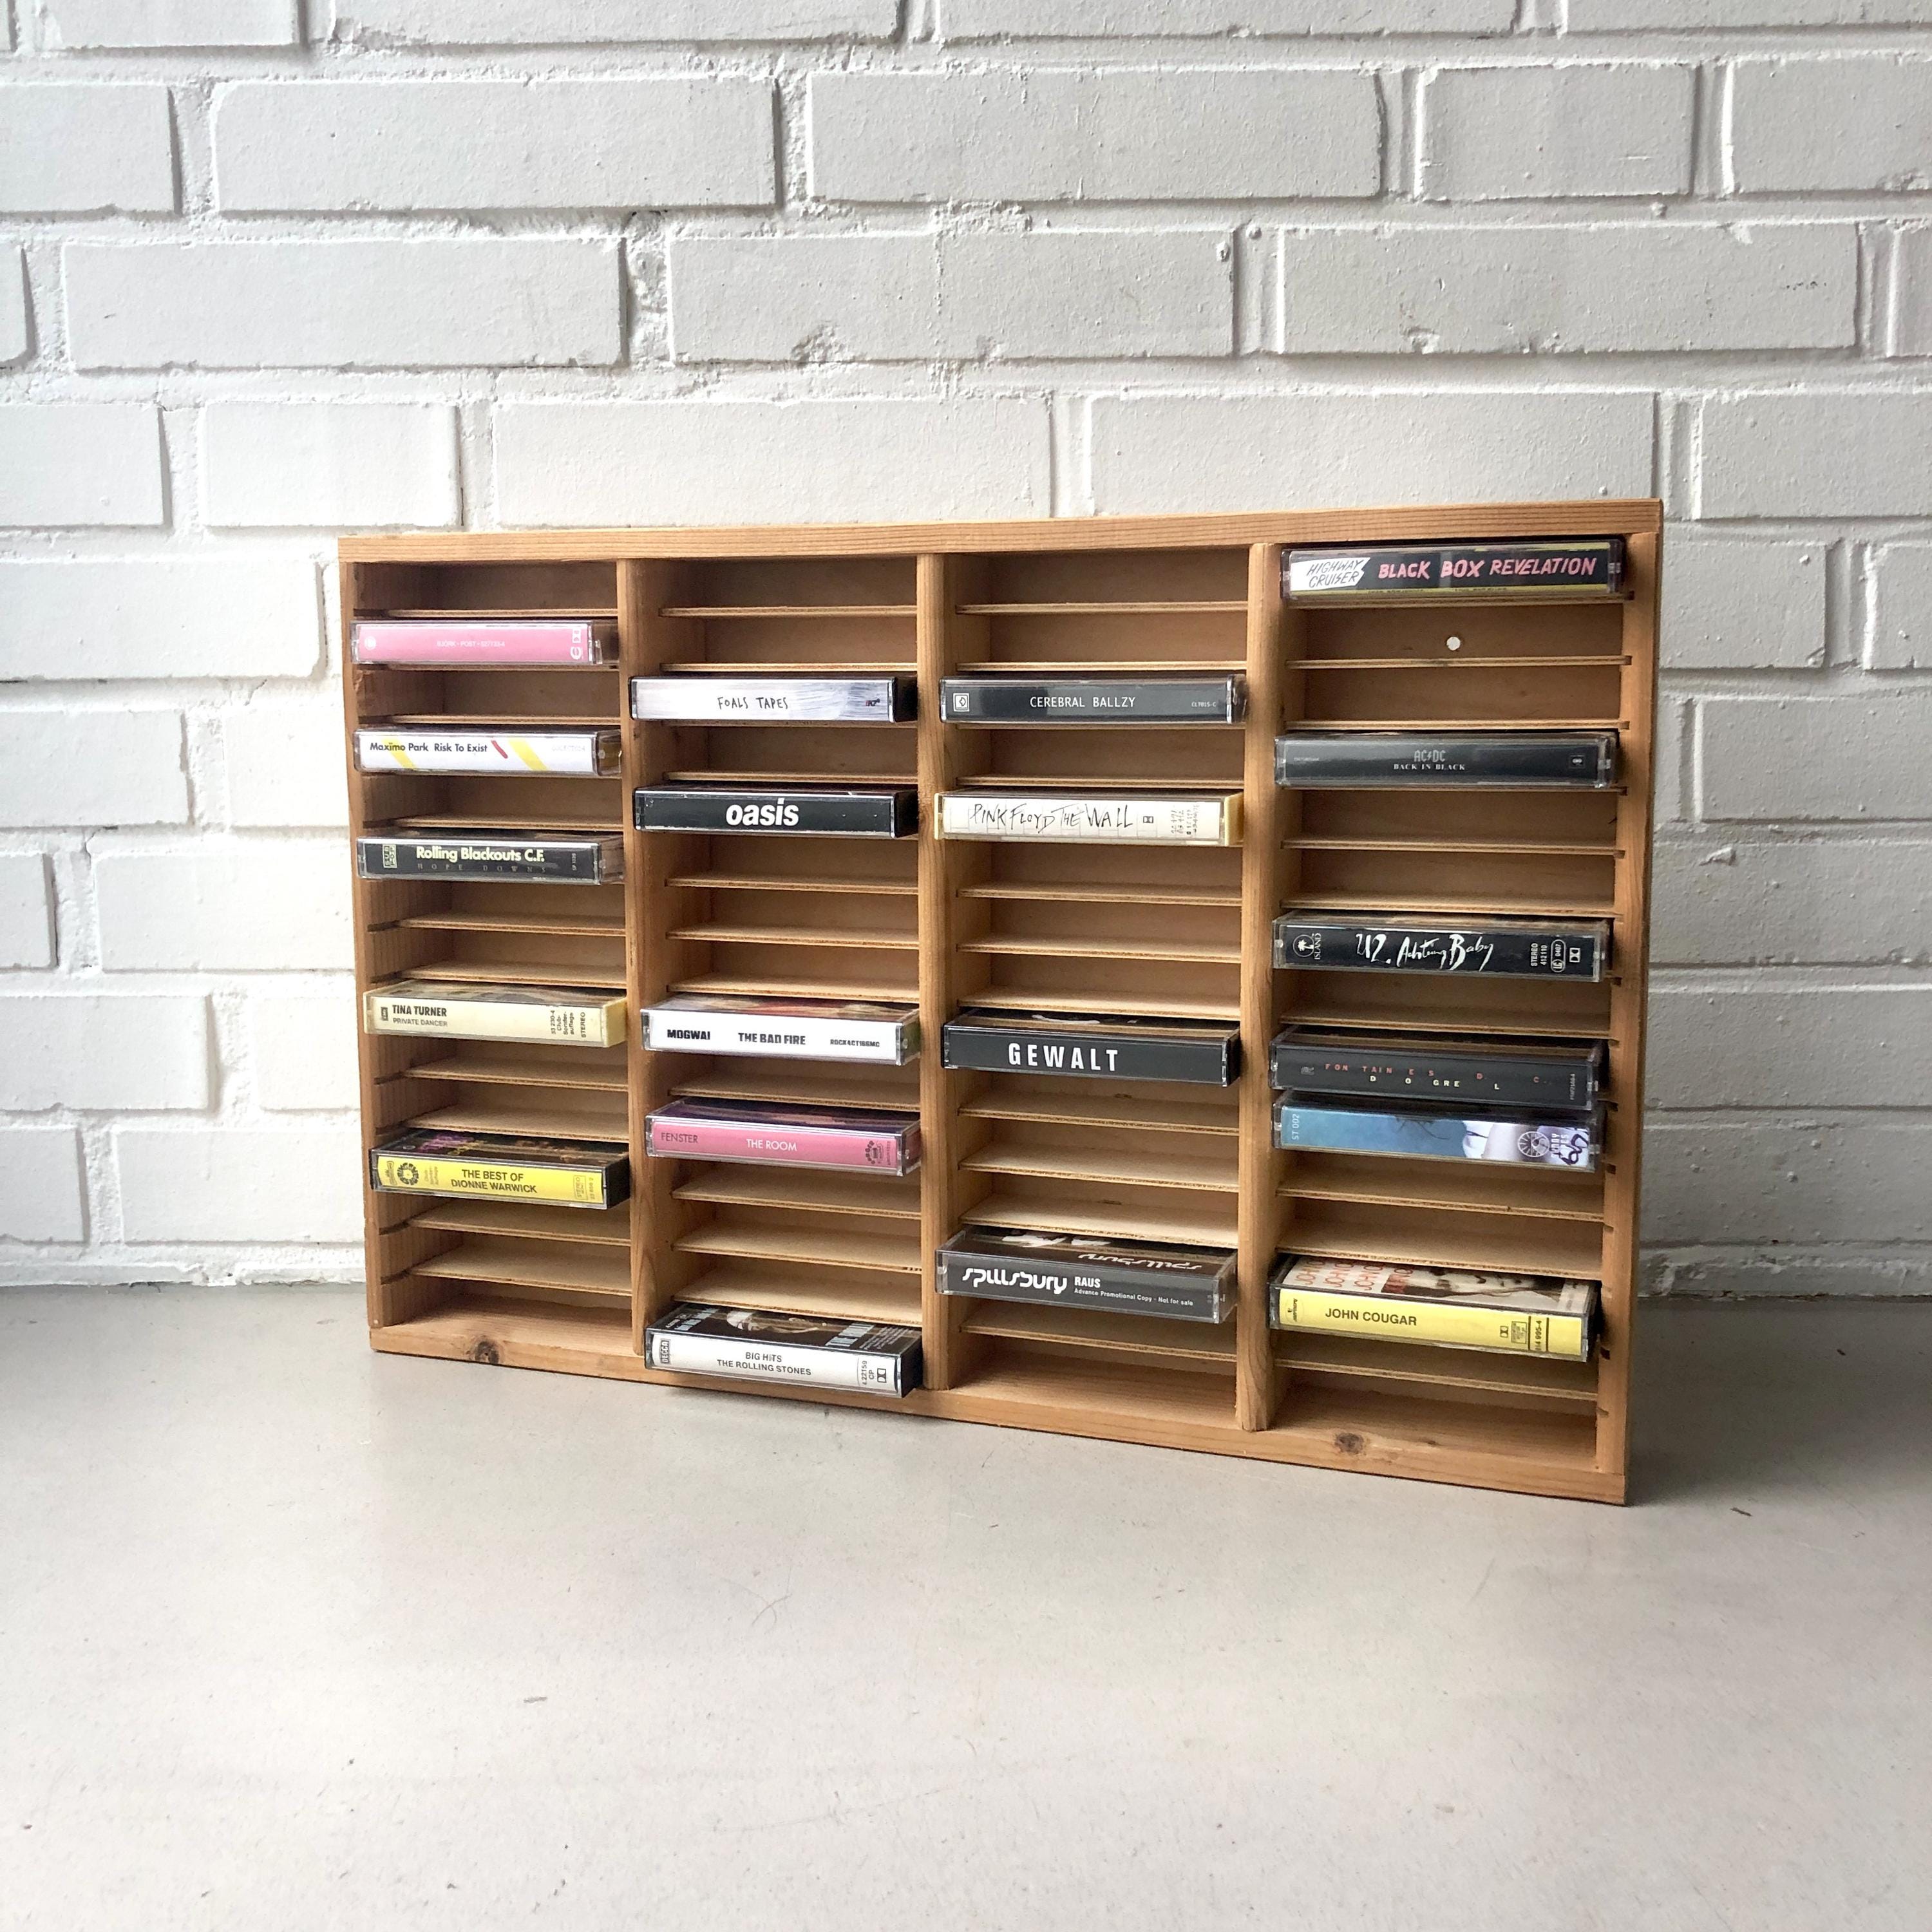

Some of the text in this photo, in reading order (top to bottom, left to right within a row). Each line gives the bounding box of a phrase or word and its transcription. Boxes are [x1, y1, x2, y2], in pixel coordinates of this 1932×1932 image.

[1307, 558, 1365, 576] HIGHWAY
[1378, 557, 1597, 580] BLACK BOX REVELATION
[1309, 571, 1359, 589] CRUISER
[717, 697, 788, 710] FOALS TAPES
[1030, 696, 1136, 708] CEREBRAL BALLZY
[408, 743, 428, 752] Park
[434, 743, 452, 752] Risk
[455, 744, 464, 752] To
[467, 744, 487, 753] Exist
[726, 798, 799, 826] oasis
[969, 803, 1133, 834] PINK FLOYD THE WALL
[416, 845, 545, 863] Rolling Blackouts C.F.
[483, 865, 546, 873] DOWNS
[1449, 934, 1493, 971] Baby
[392, 1004, 412, 1015] TINA
[414, 1006, 448, 1017] TURNER
[421, 1019, 448, 1027] DANCER
[667, 1029, 806, 1045] MOGWAI THE BAD FIRE
[1008, 1043, 1119, 1072] GEWALT
[661, 1132, 797, 1151] FENSTER THE ROOM
[462, 1169, 524, 1182] THE BEST OF
[451, 1179, 537, 1193] DIONNE WARWICK
[1074, 1276, 1101, 1289] RAUS
[1100, 1290, 1135, 1300] Promotional
[1137, 1294, 1152, 1303] Copy
[1325, 1308, 1417, 1326] JOHN COUGAR
[661, 1340, 669, 1363] DECCA
[745, 1352, 782, 1363] BIG HITS
[717, 1359, 811, 1376] THE ROLLING STONES
[868, 1369, 875, 1380] CP
